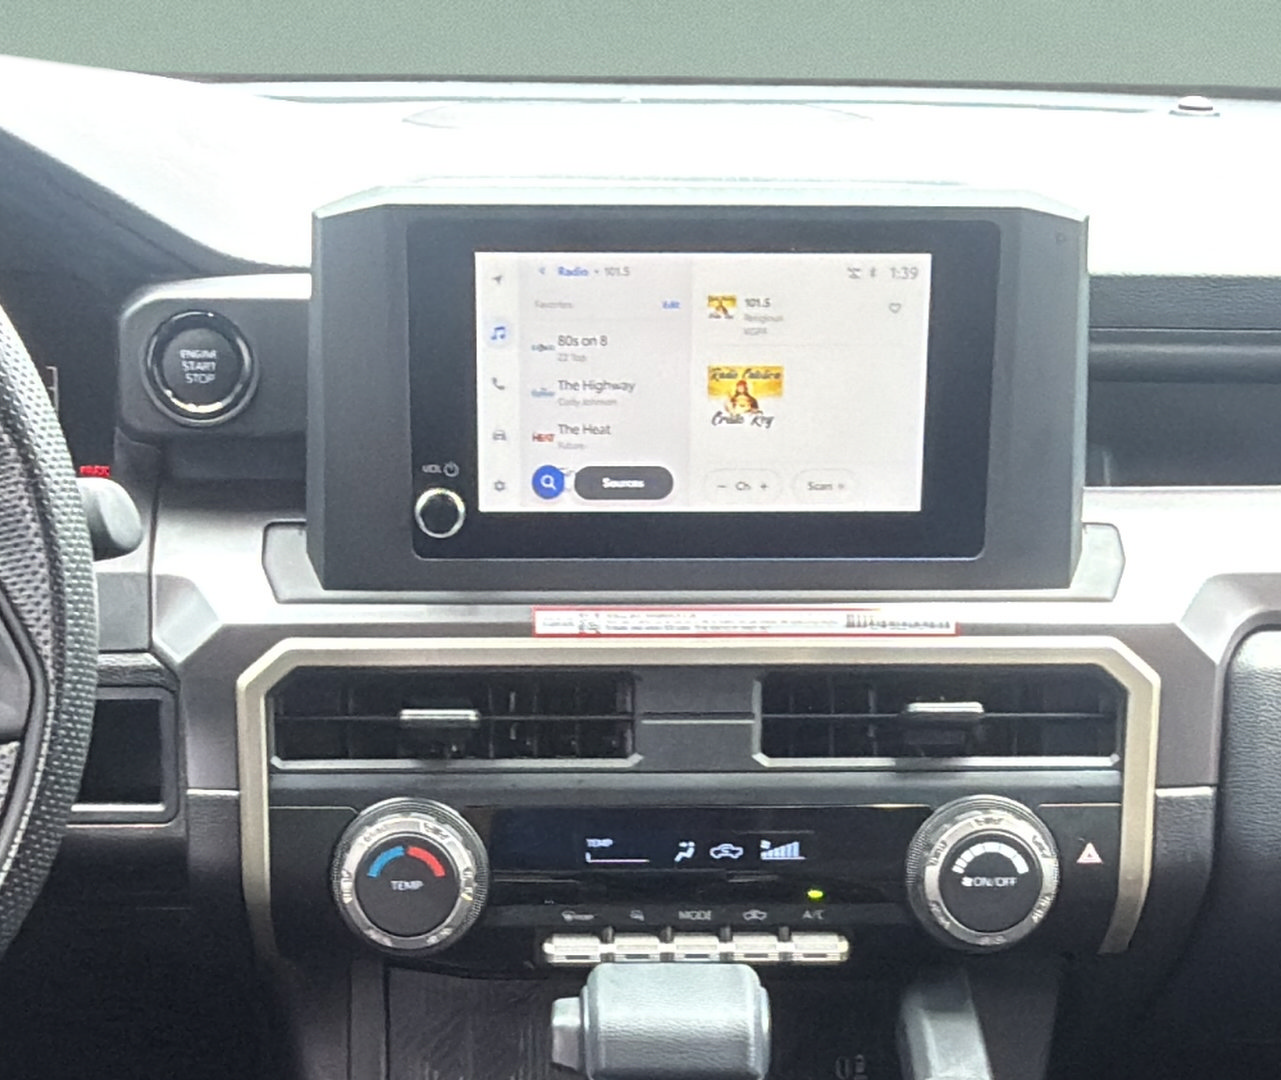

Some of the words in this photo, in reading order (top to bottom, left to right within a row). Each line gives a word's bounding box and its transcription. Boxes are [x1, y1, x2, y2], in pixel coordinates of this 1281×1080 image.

[558, 266, 589, 277] Radio
[604, 267, 631, 277] 101.5
[889, 266, 919, 280] 1:39
[744, 298, 771, 308] 101.5
[558, 335, 579, 347] 80s
[581, 338, 597, 347] on
[599, 335, 608, 346] 8
[181, 361, 216, 372] START
[185, 373, 216, 384] STOP
[558, 380, 580, 391] The
[583, 380, 636, 393] Highway
[558, 424, 580, 436] The
[583, 424, 612, 436] Heat
[602, 477, 646, 489] Sources
[808, 481, 833, 491] Scan
[390, 880, 424, 891] TEMP
[973, 876, 1018, 887] ON/OFF
[678, 909, 712, 920] MODE
[801, 909, 824, 920] A/C
